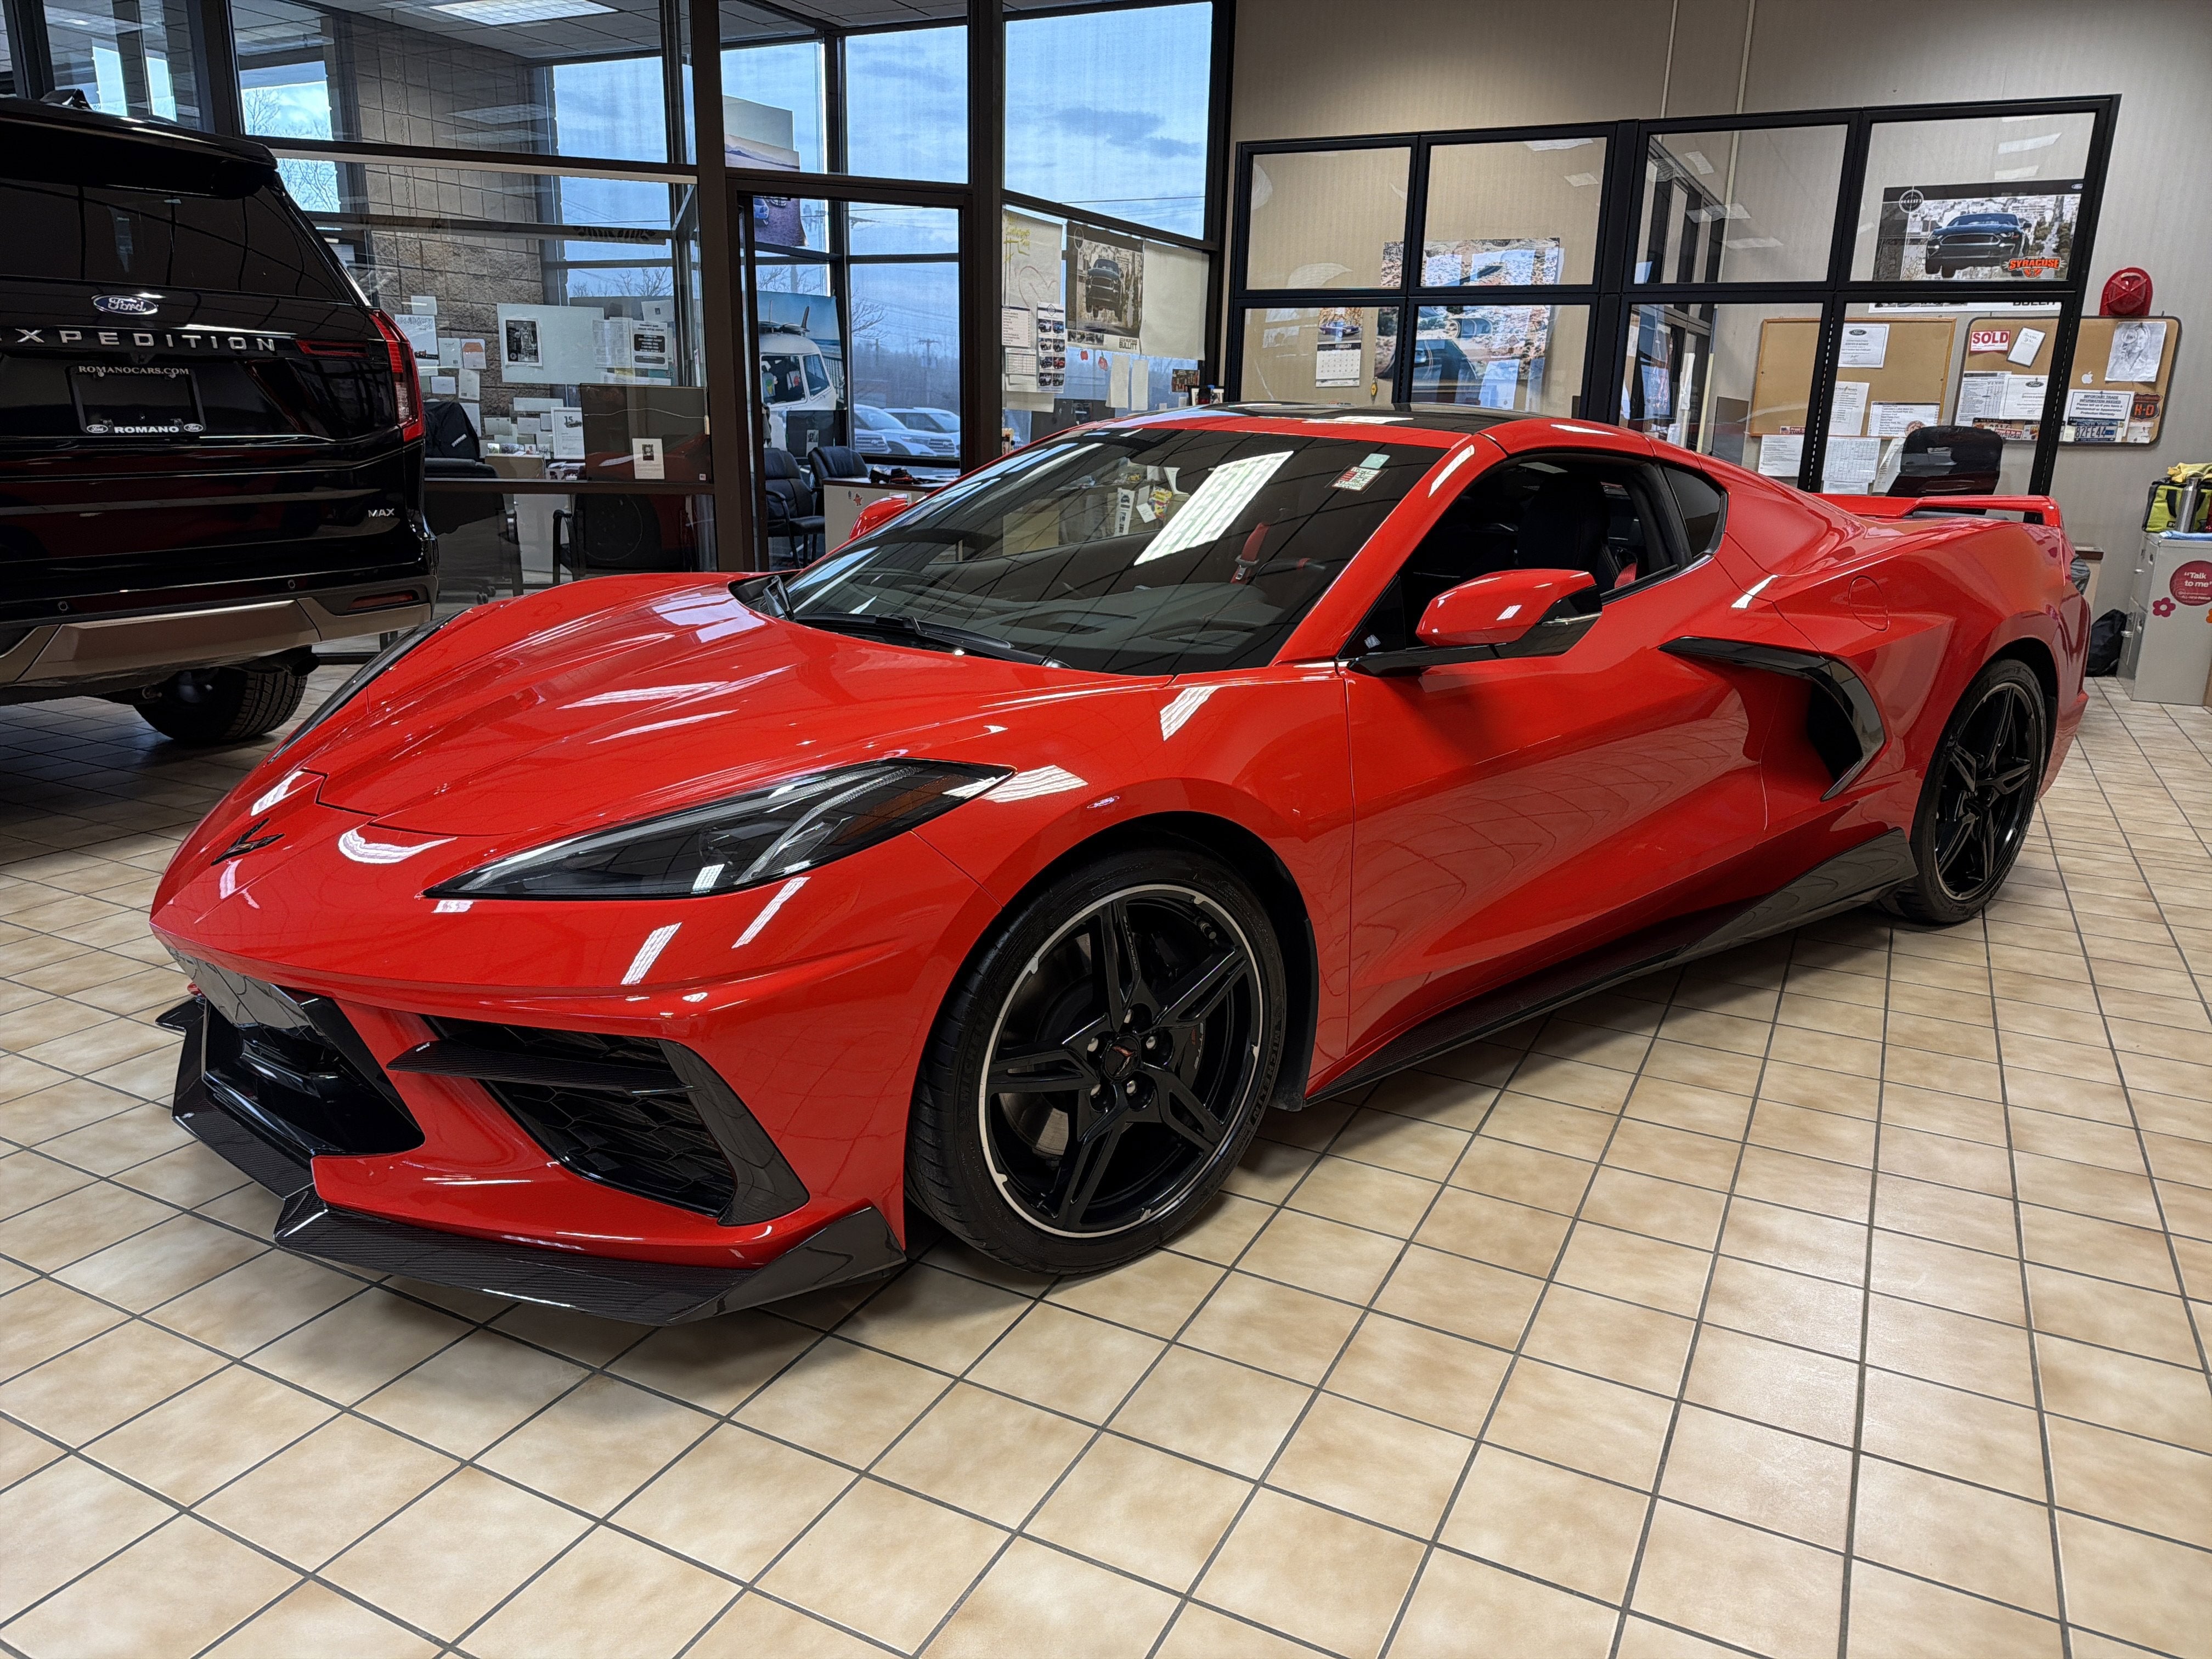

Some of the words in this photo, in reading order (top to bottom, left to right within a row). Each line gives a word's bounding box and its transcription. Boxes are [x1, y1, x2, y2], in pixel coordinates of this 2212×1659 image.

[2010, 259, 2060, 270] SYRACUSE
[0, 328, 275, 352] XPEDITION
[1972, 332, 2009, 344] SOLD
[78, 365, 189, 375] ROMANOCARS.COM
[368, 508, 395, 518] MAX
[1251, 1029, 1281, 1121] MICHELIN
